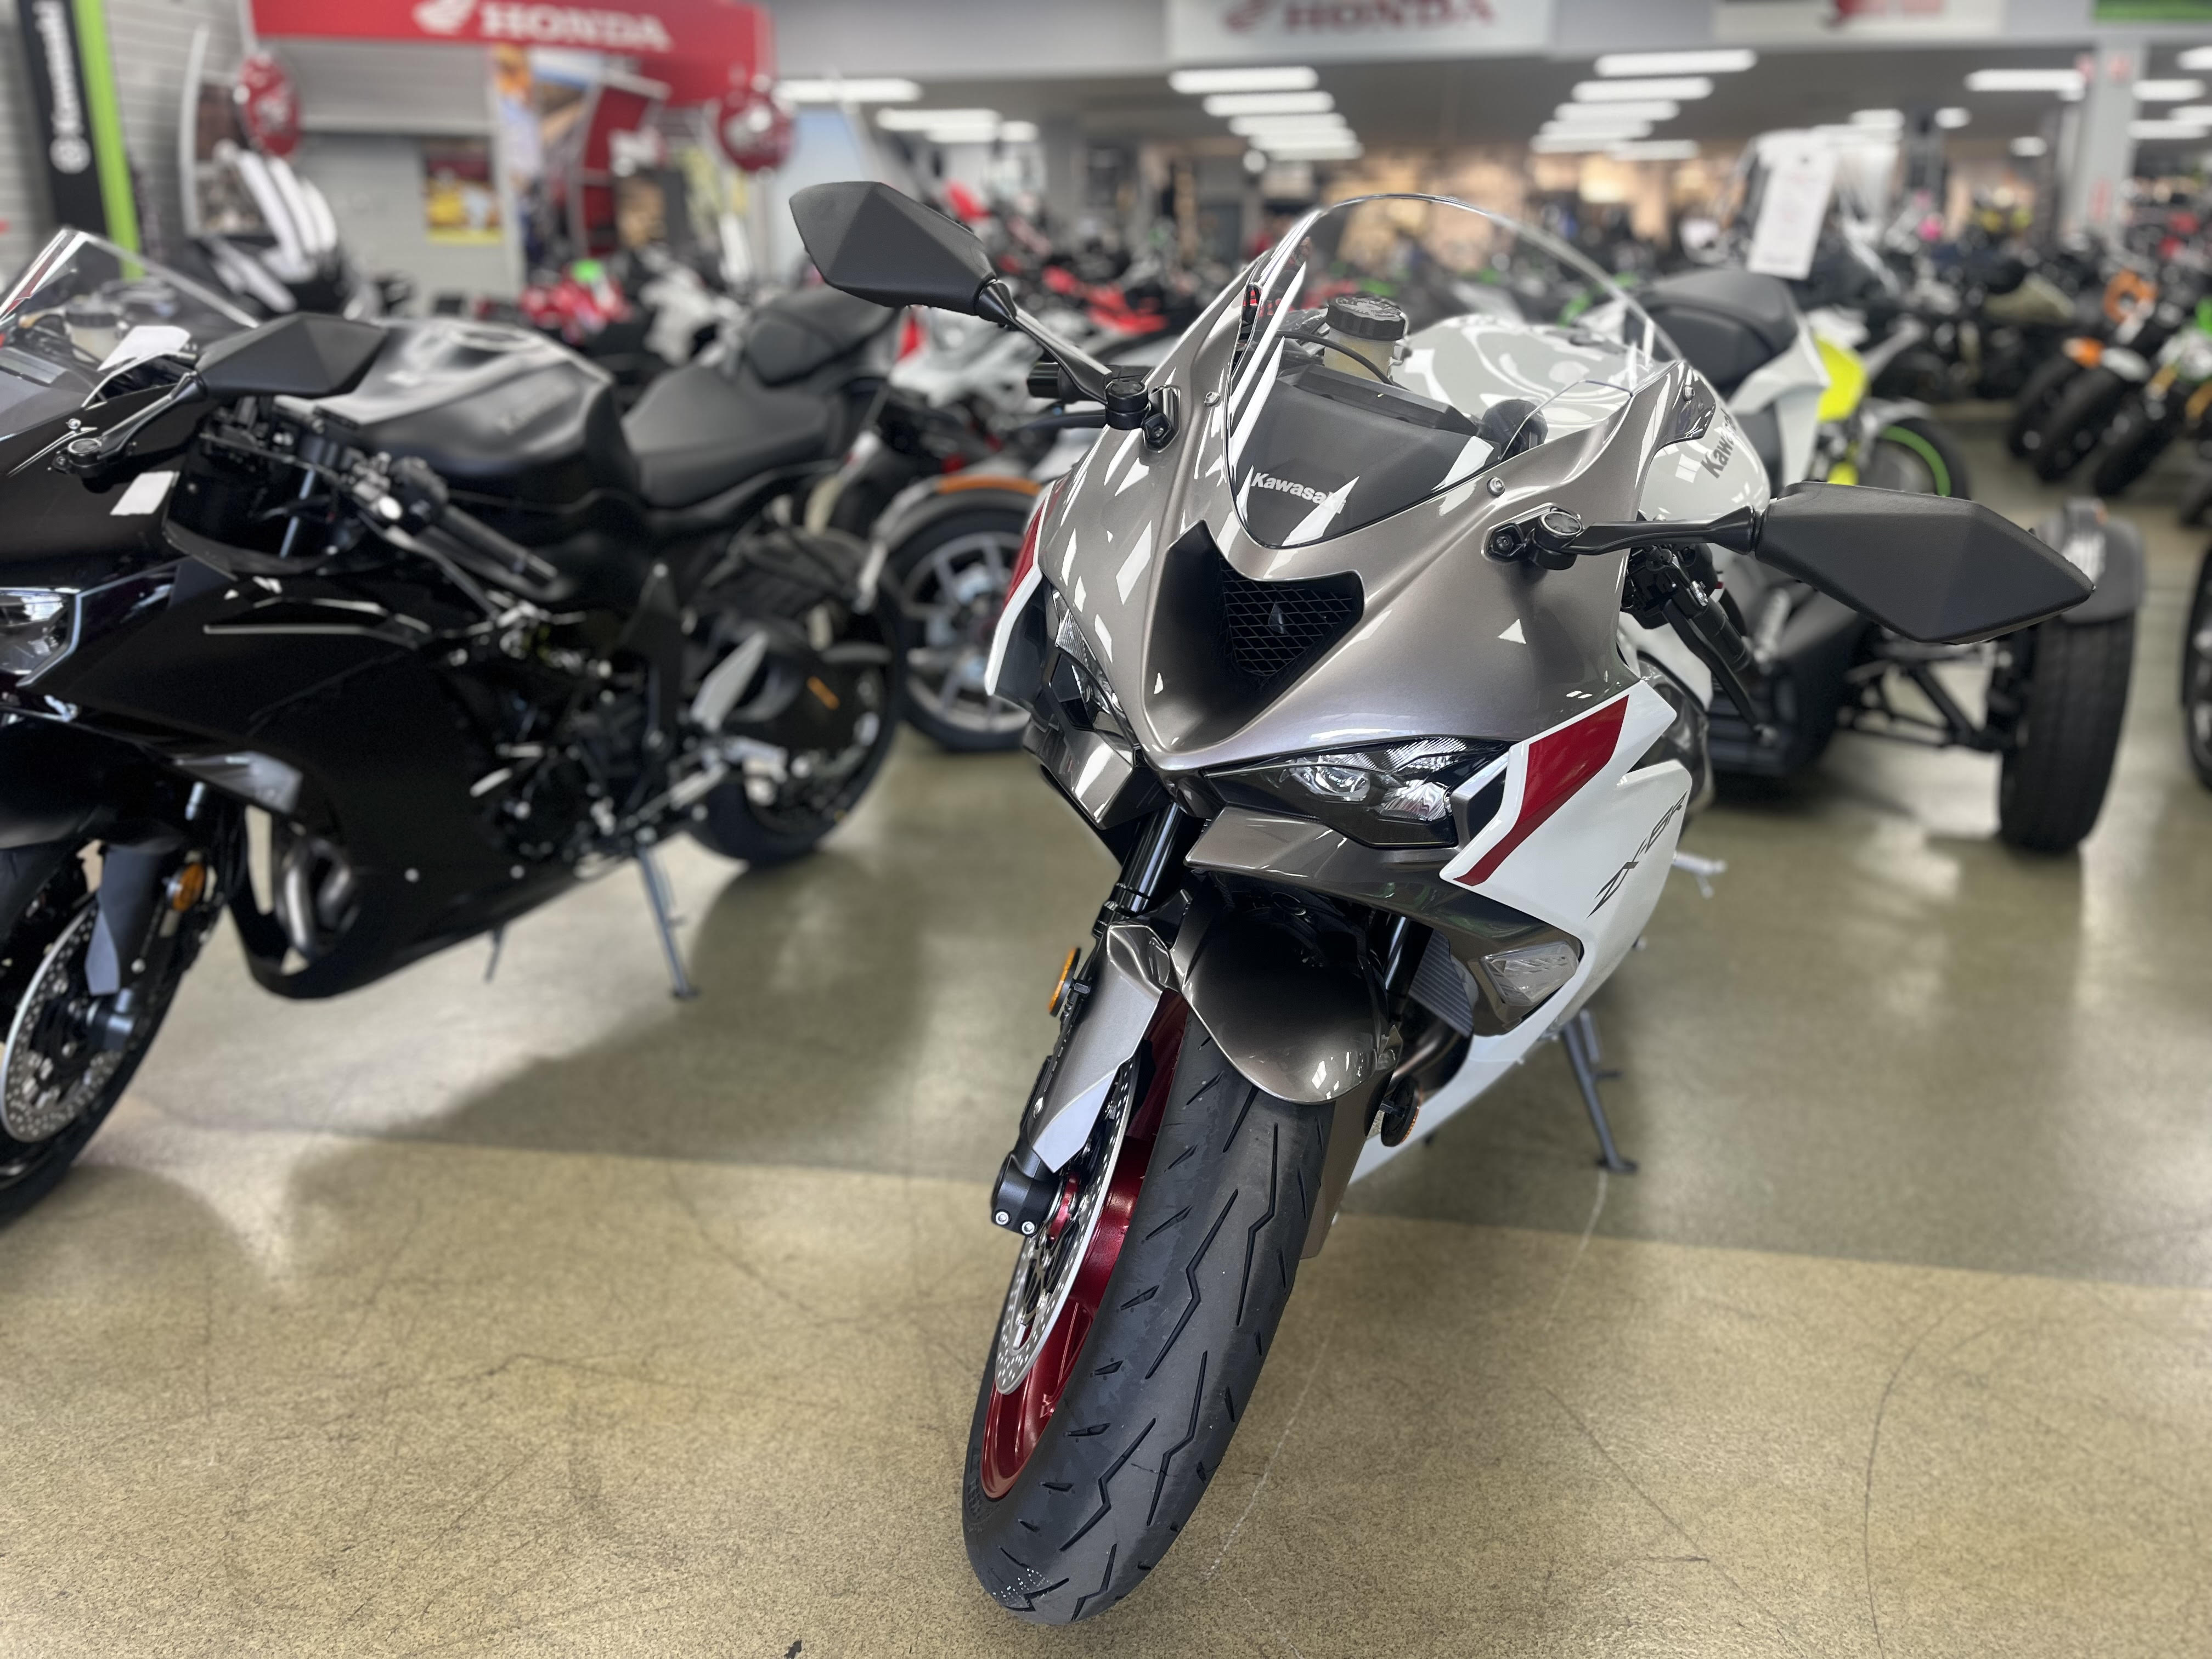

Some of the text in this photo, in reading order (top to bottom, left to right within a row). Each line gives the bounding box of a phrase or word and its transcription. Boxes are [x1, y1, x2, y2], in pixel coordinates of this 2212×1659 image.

[478, 1, 672, 52] HONDA
[1284, 0, 1494, 33] HONDA
[1250, 472, 1347, 514] Kawasai
